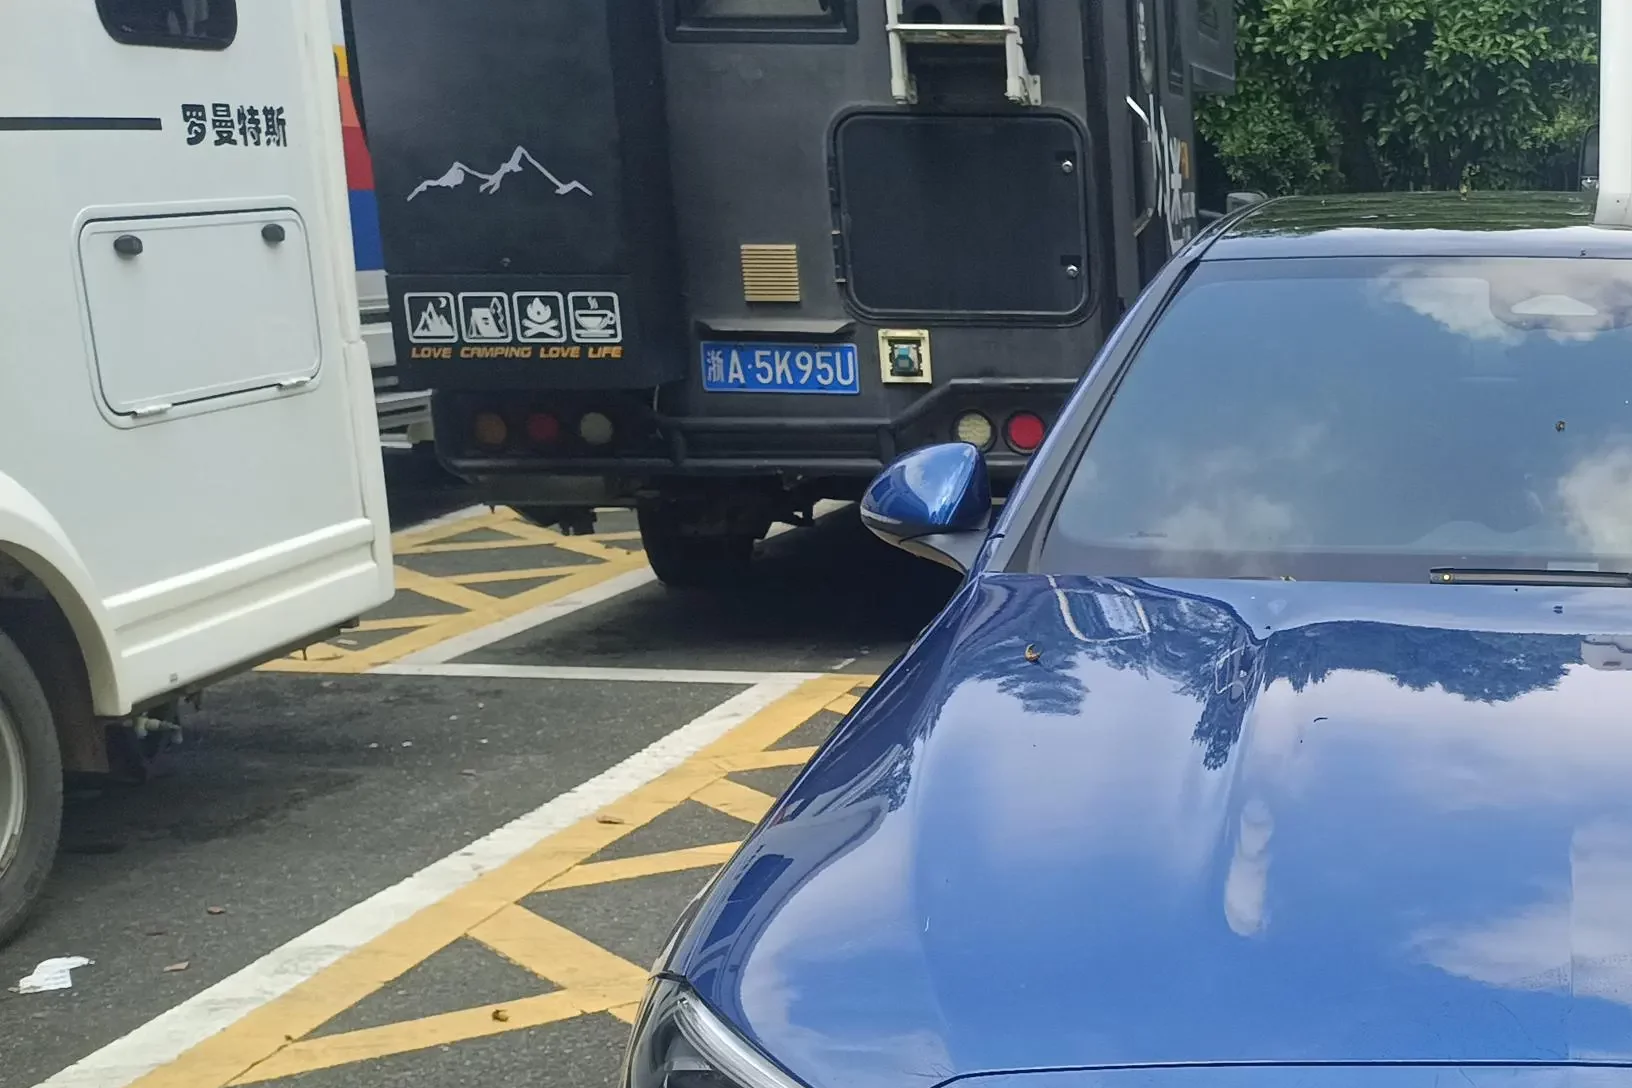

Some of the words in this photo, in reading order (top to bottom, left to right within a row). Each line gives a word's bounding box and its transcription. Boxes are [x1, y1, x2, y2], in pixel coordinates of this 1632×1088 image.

[181, 103, 287, 147] 罗曼特斯
[411, 346, 452, 359] LOVE
[460, 346, 532, 359] CAMPING
[539, 346, 580, 358] LOVE
[588, 346, 622, 358] LIFE
